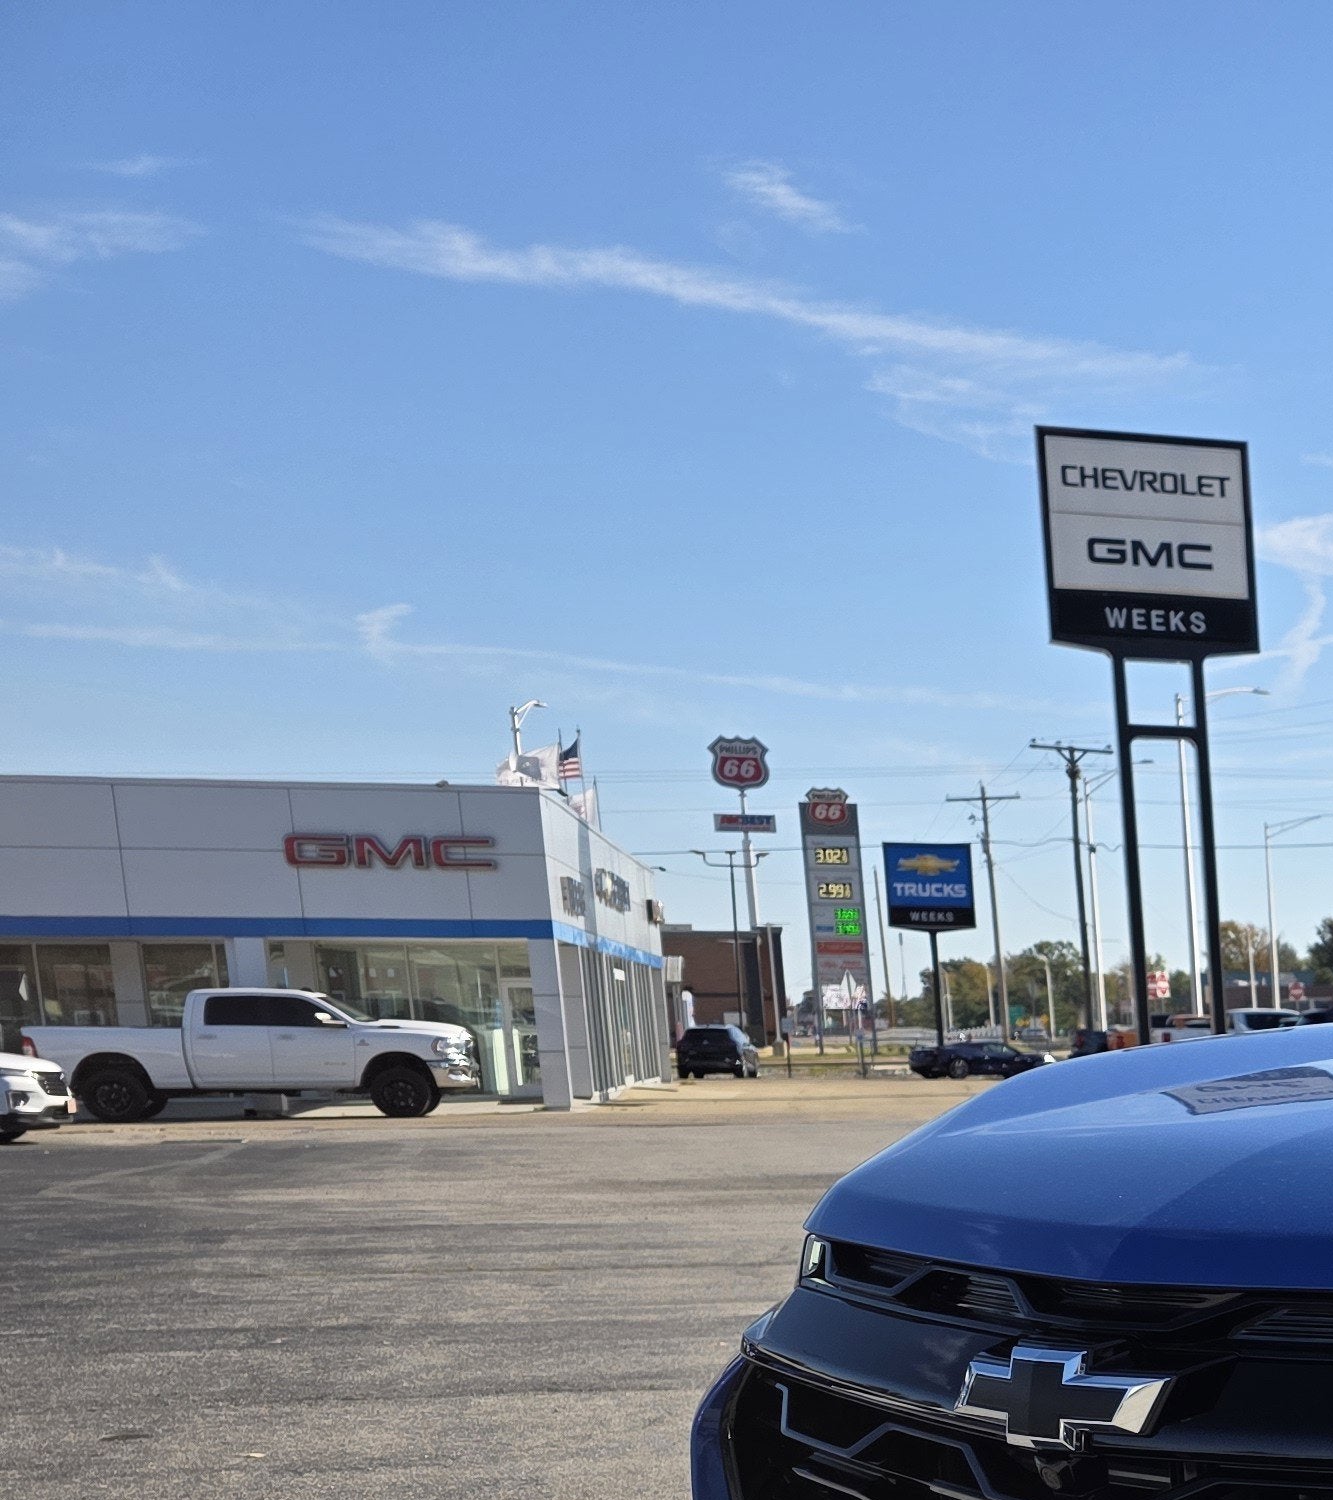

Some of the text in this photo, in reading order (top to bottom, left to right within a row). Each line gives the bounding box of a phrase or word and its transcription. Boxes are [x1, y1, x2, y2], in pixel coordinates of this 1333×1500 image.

[1060, 464, 1231, 498] CHEVROLET
[1087, 537, 1214, 571] GMC
[1104, 606, 1207, 634] WEEKS
[723, 759, 757, 779] 66
[814, 803, 842, 820] 66
[282, 833, 498, 870] GMC
[893, 882, 967, 898] TRUCKS
[910, 911, 955, 922] WEEKS
